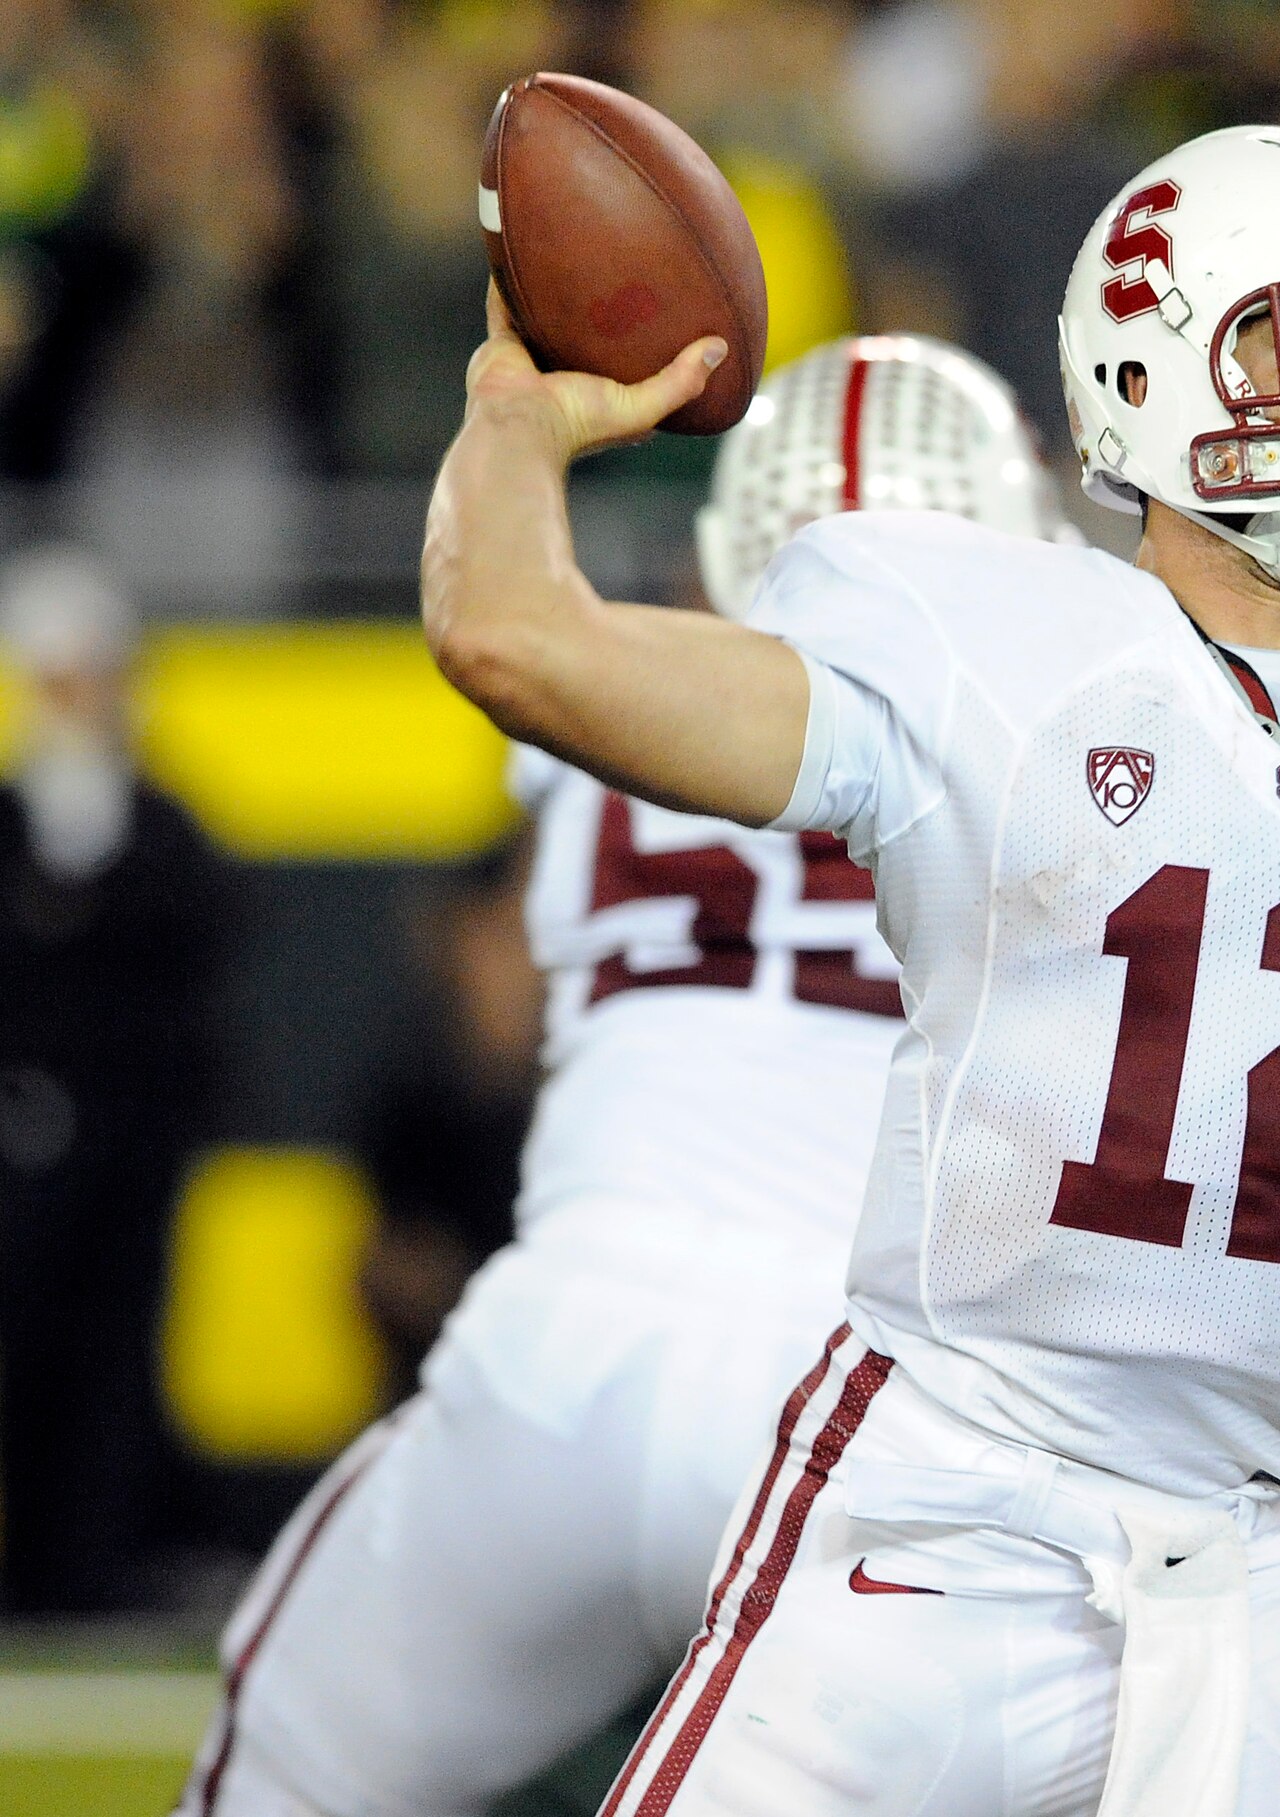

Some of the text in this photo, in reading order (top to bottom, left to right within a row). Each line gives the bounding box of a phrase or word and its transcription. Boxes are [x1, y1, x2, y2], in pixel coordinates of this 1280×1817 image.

[1101, 179, 1181, 324] S
[1091, 750, 1151, 796] PAC
[1103, 781, 1138, 808] 10
